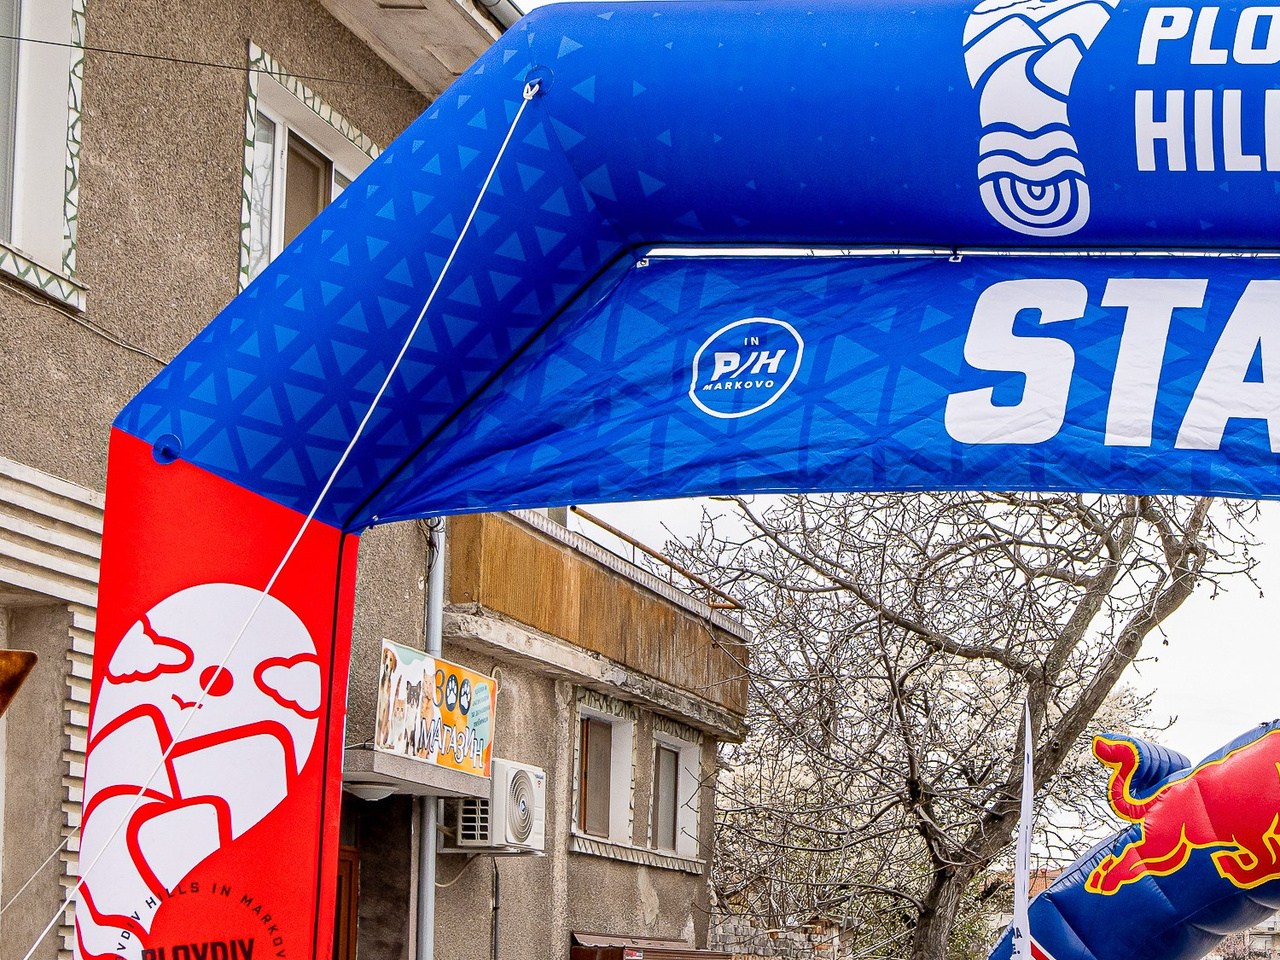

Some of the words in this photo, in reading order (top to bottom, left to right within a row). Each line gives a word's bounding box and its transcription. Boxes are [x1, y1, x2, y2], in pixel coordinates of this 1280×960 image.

[744, 337, 759, 346] IN
[711, 349, 787, 381] P/H
[702, 380, 775, 391] MARKOVO
[417, 717, 484, 769] МАГАЗИН
[145, 882, 200, 909] HILLS
[212, 883, 232, 897] IN
